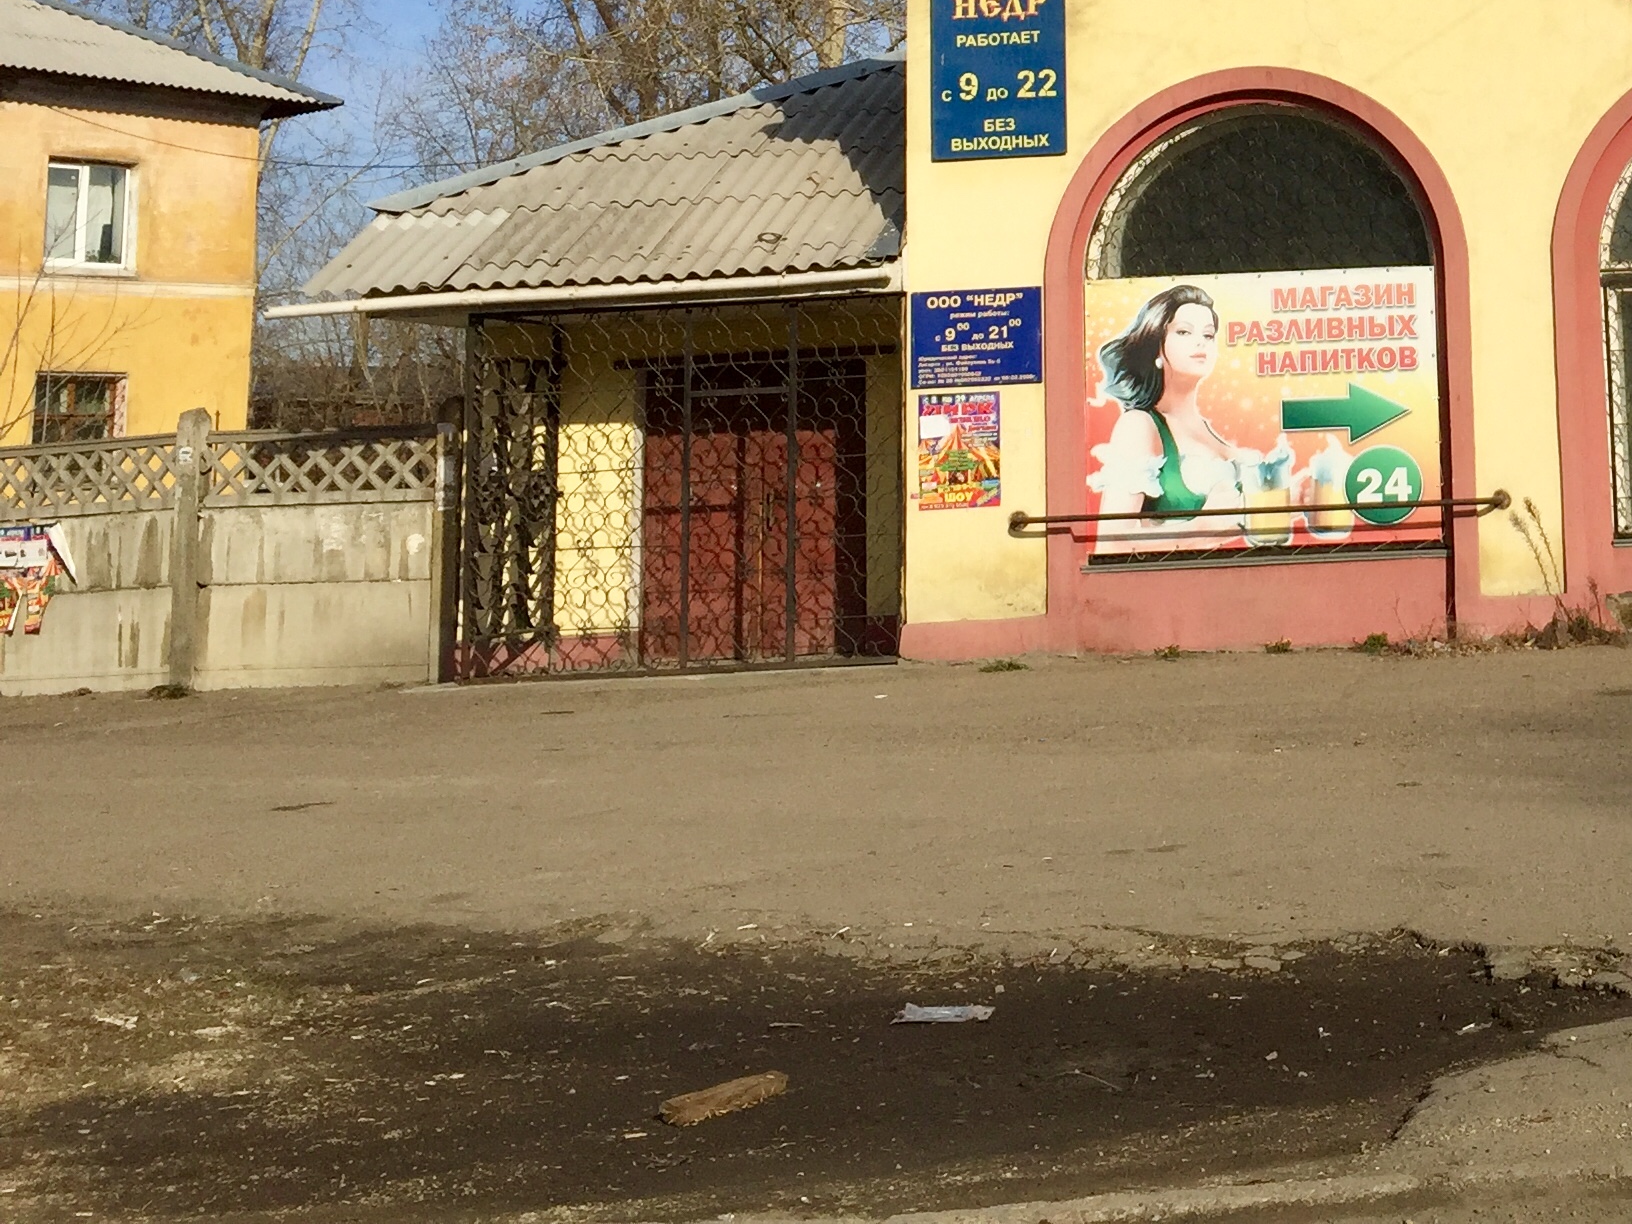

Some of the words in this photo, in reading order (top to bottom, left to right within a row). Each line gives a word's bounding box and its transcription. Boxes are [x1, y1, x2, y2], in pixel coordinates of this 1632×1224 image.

[956, 30, 1041, 47] РАБОТАЕТ
[959, 72, 979, 101] 9
[1016, 68, 1058, 98] 22
[983, 118, 1016, 132] БЕЗ
[951, 134, 1050, 152] ВЫХОДНЫХ
[926, 295, 961, 309] ООО
[1272, 282, 1416, 311] МАГАЗИН
[1227, 314, 1418, 345] РАЗЛИВНЫХ
[961, 341, 1014, 352] ВЫХОДНЫХ
[1257, 346, 1418, 376] НАПИТКОВ
[1356, 466, 1413, 504] 24
[944, 491, 973, 503] ШОУ
